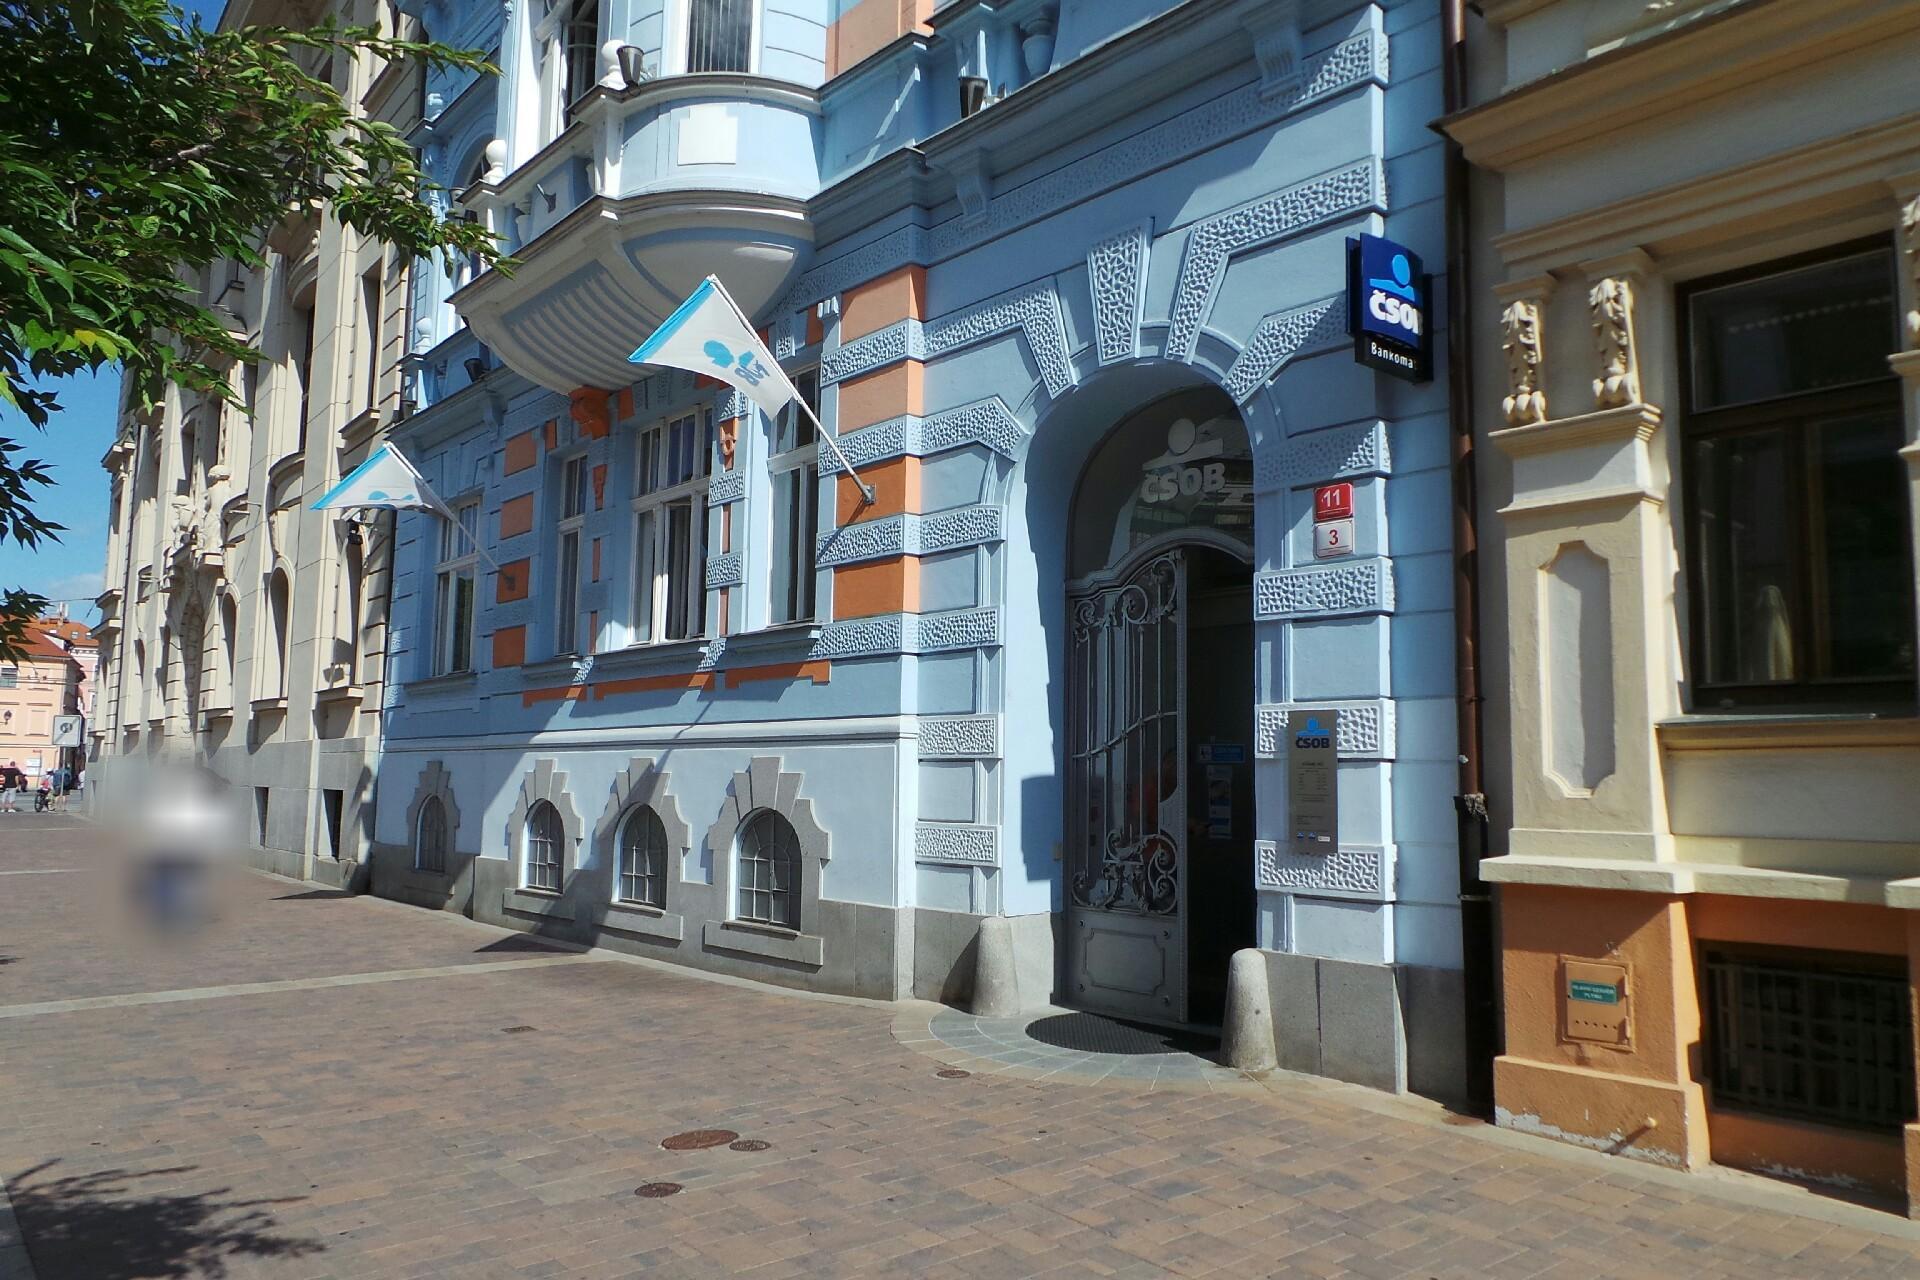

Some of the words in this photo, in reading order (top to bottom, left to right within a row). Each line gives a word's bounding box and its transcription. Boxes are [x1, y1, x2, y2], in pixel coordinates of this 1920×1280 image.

[1371, 341, 1417, 370] Bankoma
[1323, 488, 1341, 508] 11
[1328, 529, 1339, 546] 3
[1295, 736, 1330, 749] ČSOB
